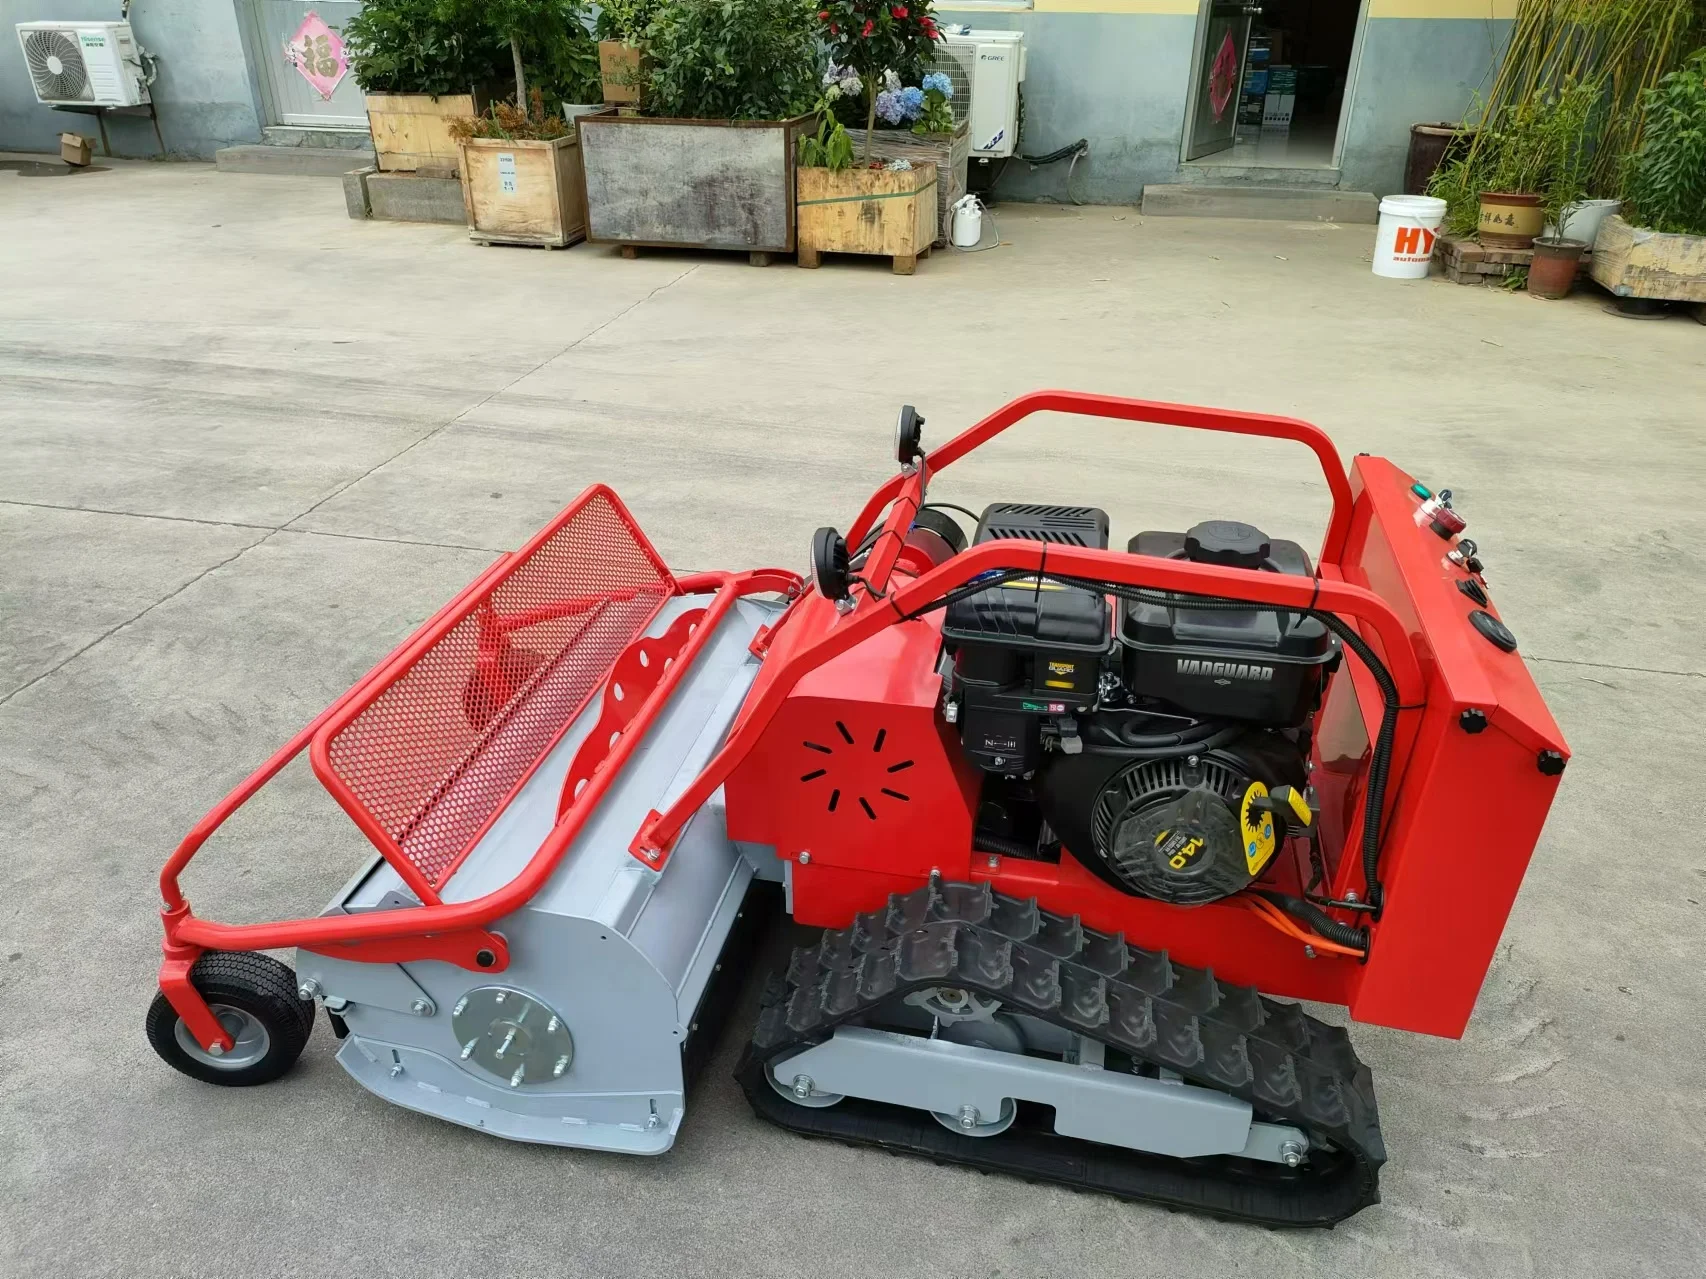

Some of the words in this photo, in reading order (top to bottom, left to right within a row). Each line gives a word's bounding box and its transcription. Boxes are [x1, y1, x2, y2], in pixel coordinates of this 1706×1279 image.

[1049, 661, 1075, 669] TRANSPORT
[1176, 659, 1274, 681] VANGUARD
[1169, 838, 1204, 869] 14.0
